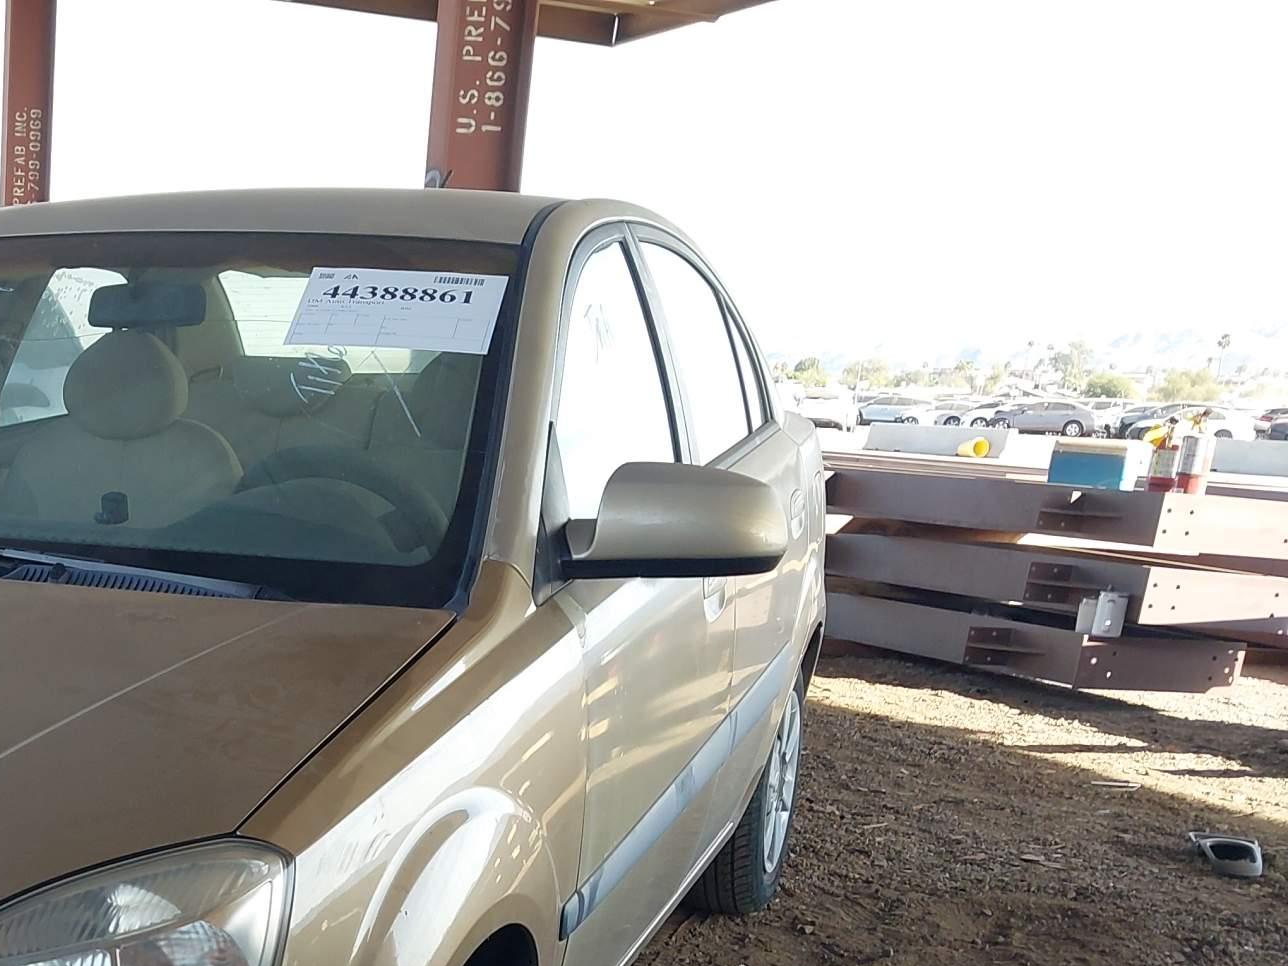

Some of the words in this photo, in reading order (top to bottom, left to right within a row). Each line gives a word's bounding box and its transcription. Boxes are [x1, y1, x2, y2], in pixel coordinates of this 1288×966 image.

[462, 0, 488, 61] PRE
[14, 107, 28, 137] INC.
[455, 80, 479, 134] U.S.
[27, 108, 42, 205] -799-0969
[322, 285, 473, 305] 44388861
